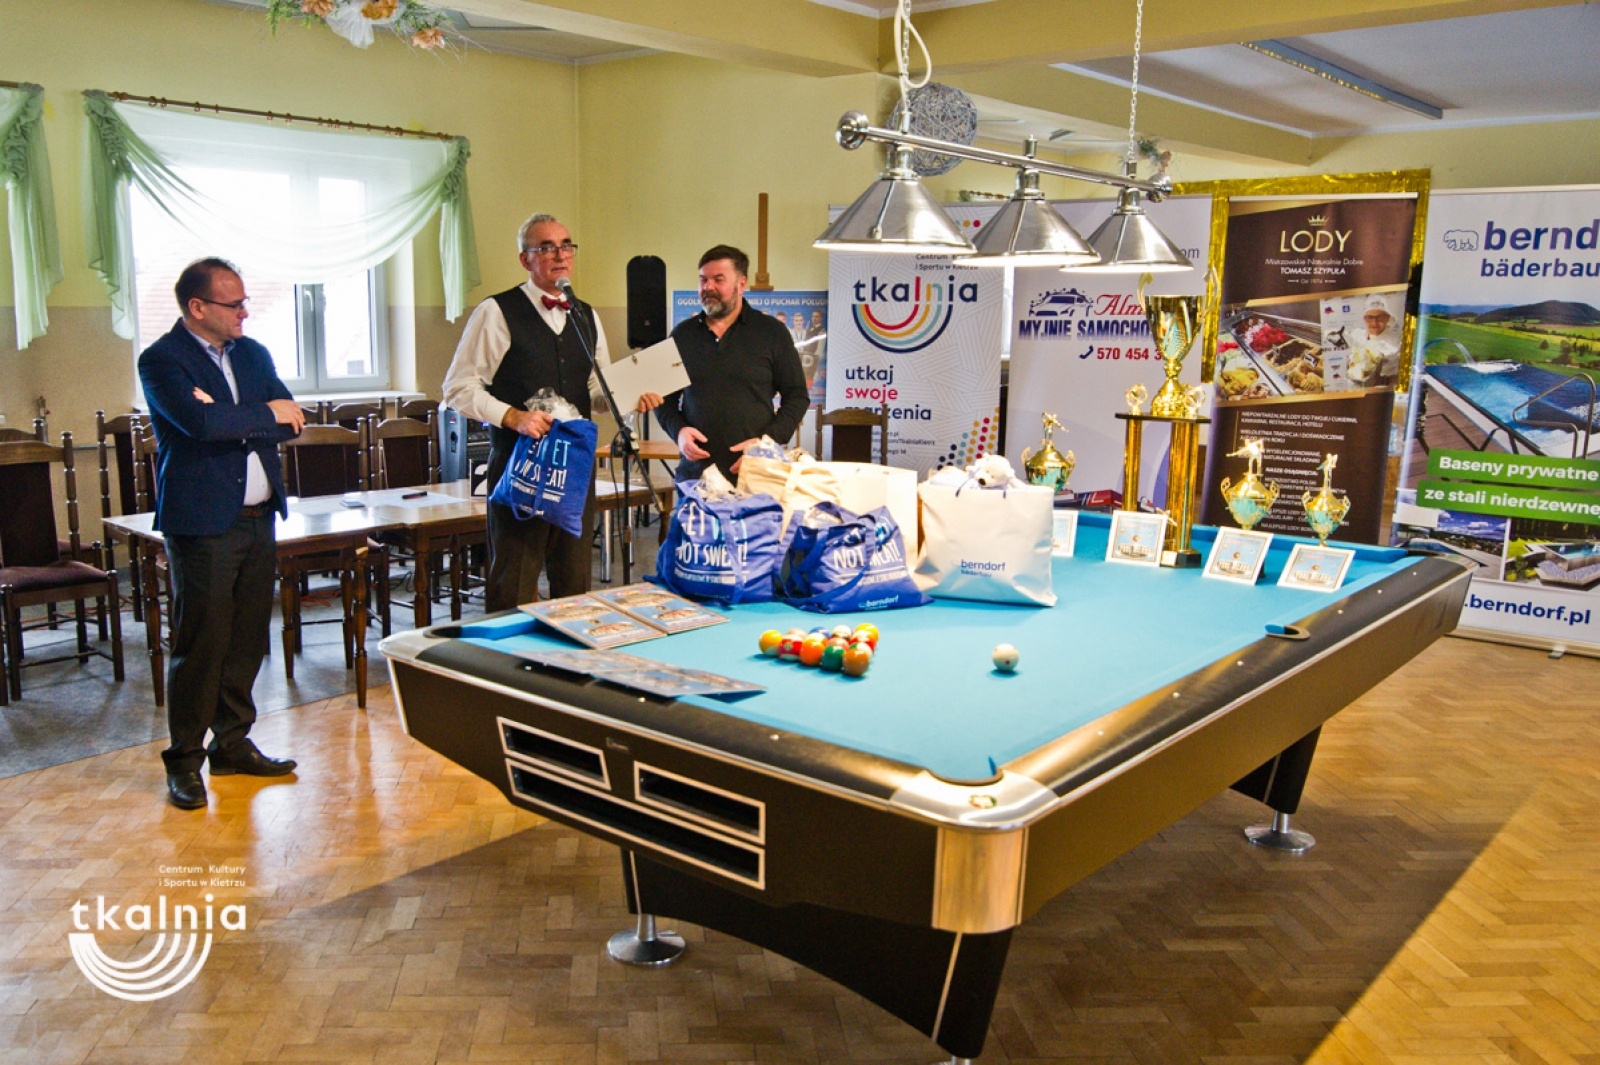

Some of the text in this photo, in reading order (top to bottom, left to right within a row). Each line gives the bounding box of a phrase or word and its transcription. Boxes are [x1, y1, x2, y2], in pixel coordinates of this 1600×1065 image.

[1280, 230, 1352, 252] LODY
[1484, 219, 1600, 251] bernd
[1181, 247, 1199, 258] om
[919, 263, 944, 271] Sportu
[1280, 266, 1312, 274] TOMASZ
[1480, 257, 1600, 277] bäderbau
[853, 275, 978, 303] tkalnia
[1093, 294, 1146, 316] Alm
[1018, 319, 1150, 342] MYJNIE SAMOCHO
[1097, 347, 1163, 361] 570 454 3
[845, 365, 893, 385] utkaj
[845, 384, 898, 404] swoje
[1439, 456, 1599, 481] Baseny prywatne
[1425, 488, 1600, 518] ze stali nierdzewne
[703, 544, 748, 567] SWET!
[833, 545, 864, 569] NOT
[961, 559, 1006, 571] berndorf
[1465, 594, 1591, 626] .berndorf.pl
